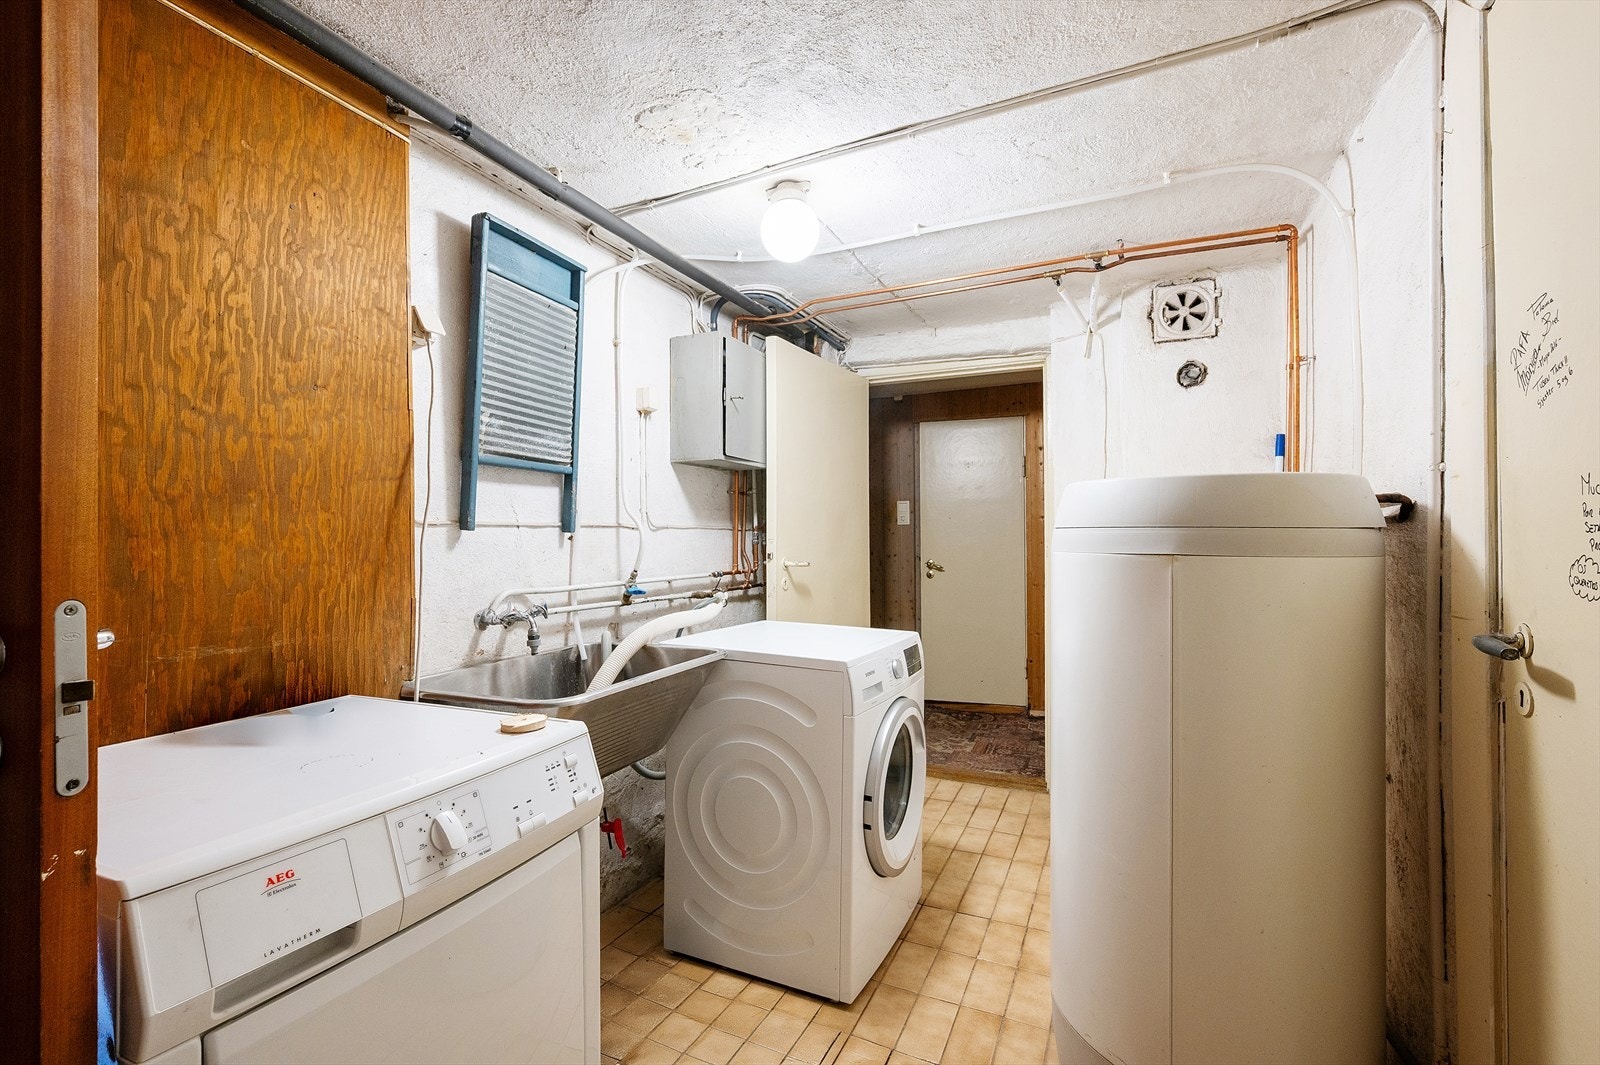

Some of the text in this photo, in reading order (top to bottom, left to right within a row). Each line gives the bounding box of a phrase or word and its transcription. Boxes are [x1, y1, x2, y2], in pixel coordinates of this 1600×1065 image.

[1568, 366, 1574, 376] 6
[266, 869, 295, 888] AEG
[272, 883, 297, 896] Electrolux
[263, 928, 321, 958] LAVATHERM
